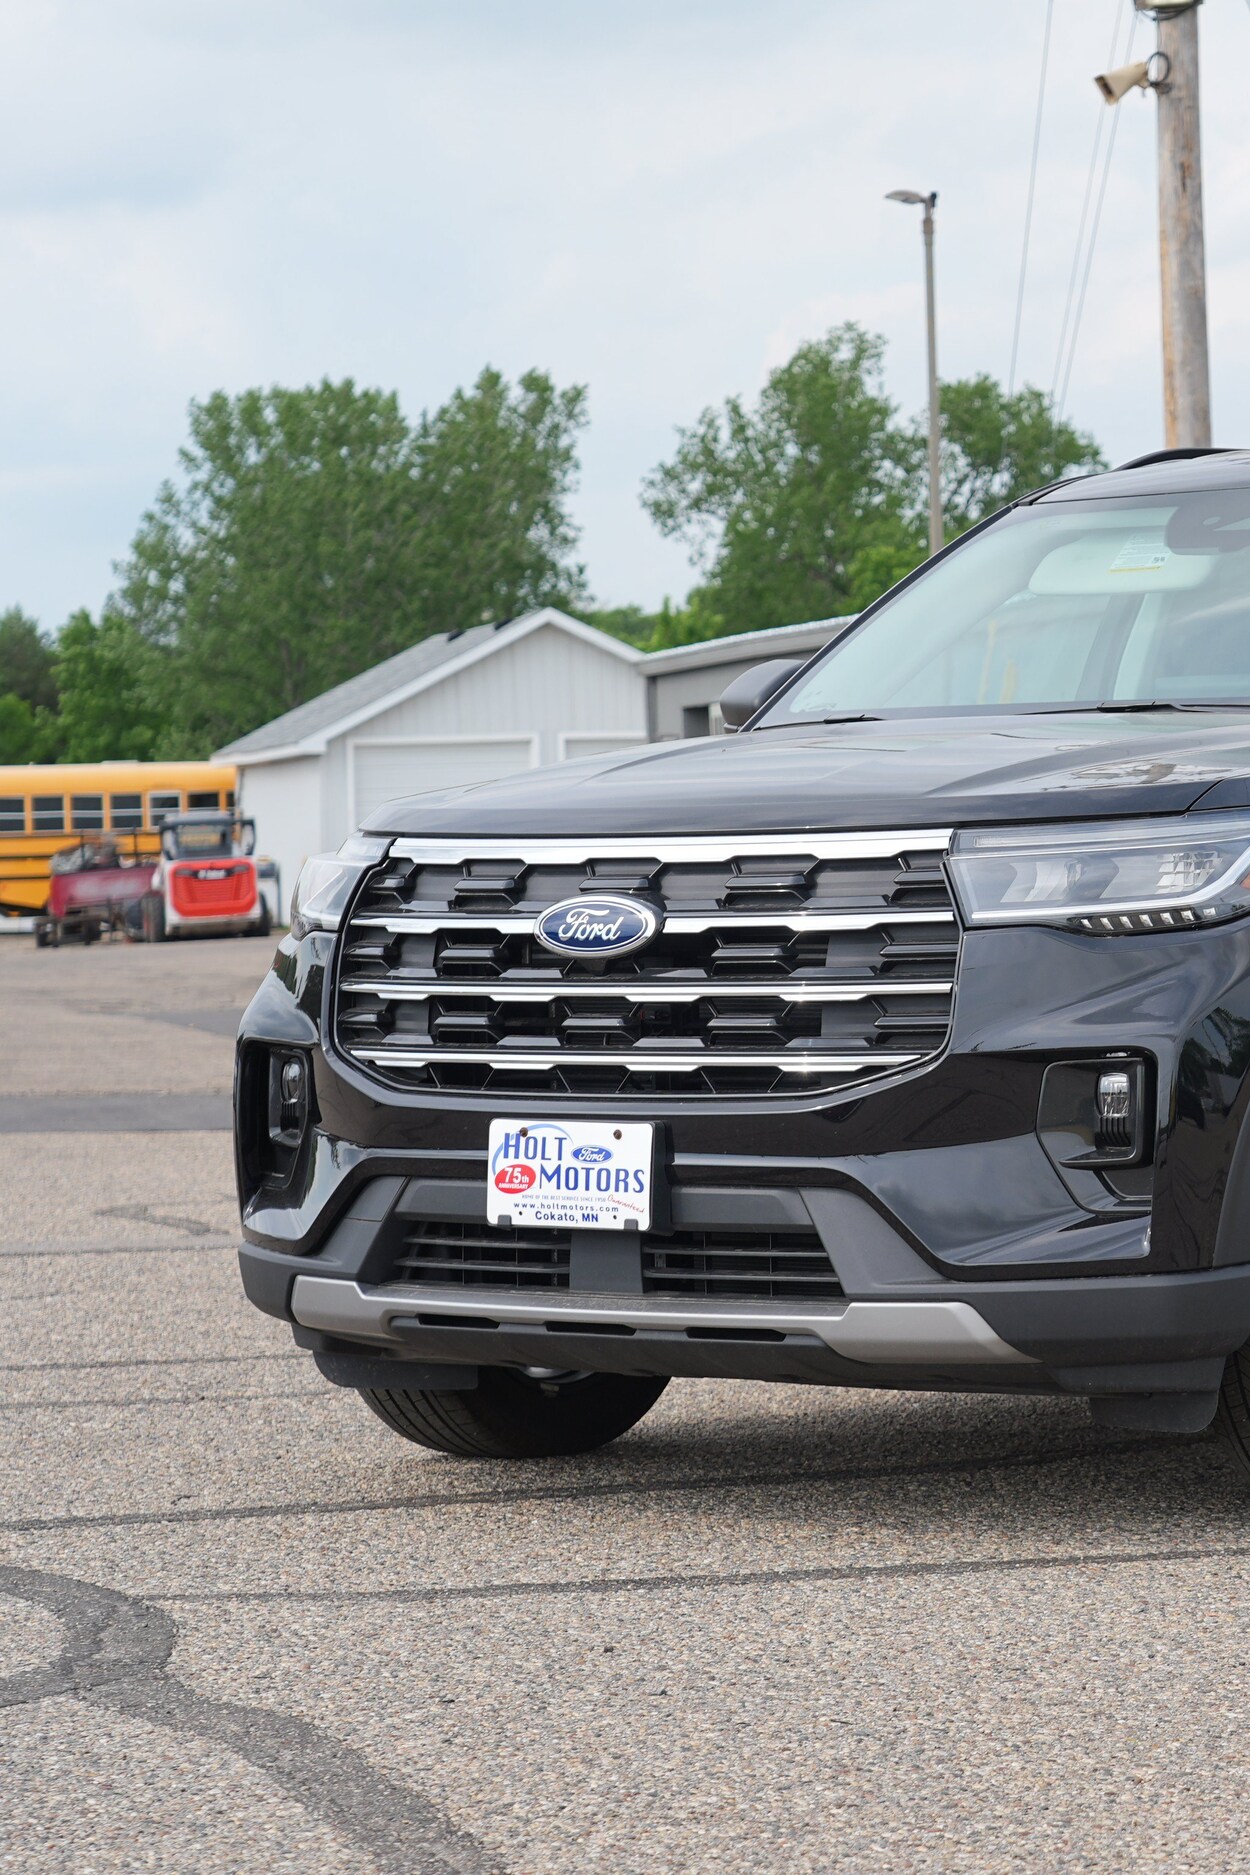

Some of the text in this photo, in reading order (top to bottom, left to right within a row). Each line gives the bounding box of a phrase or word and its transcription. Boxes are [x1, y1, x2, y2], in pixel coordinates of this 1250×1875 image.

[558, 908, 624, 942] Ford
[503, 1133, 567, 1161] HOLT
[578, 1147, 605, 1162] Ford
[505, 1167, 529, 1184] 75th
[540, 1163, 645, 1193] MOTORS
[513, 1202, 619, 1212] www.holtmotors.com
[535, 1211, 599, 1224] Cokato, MN
